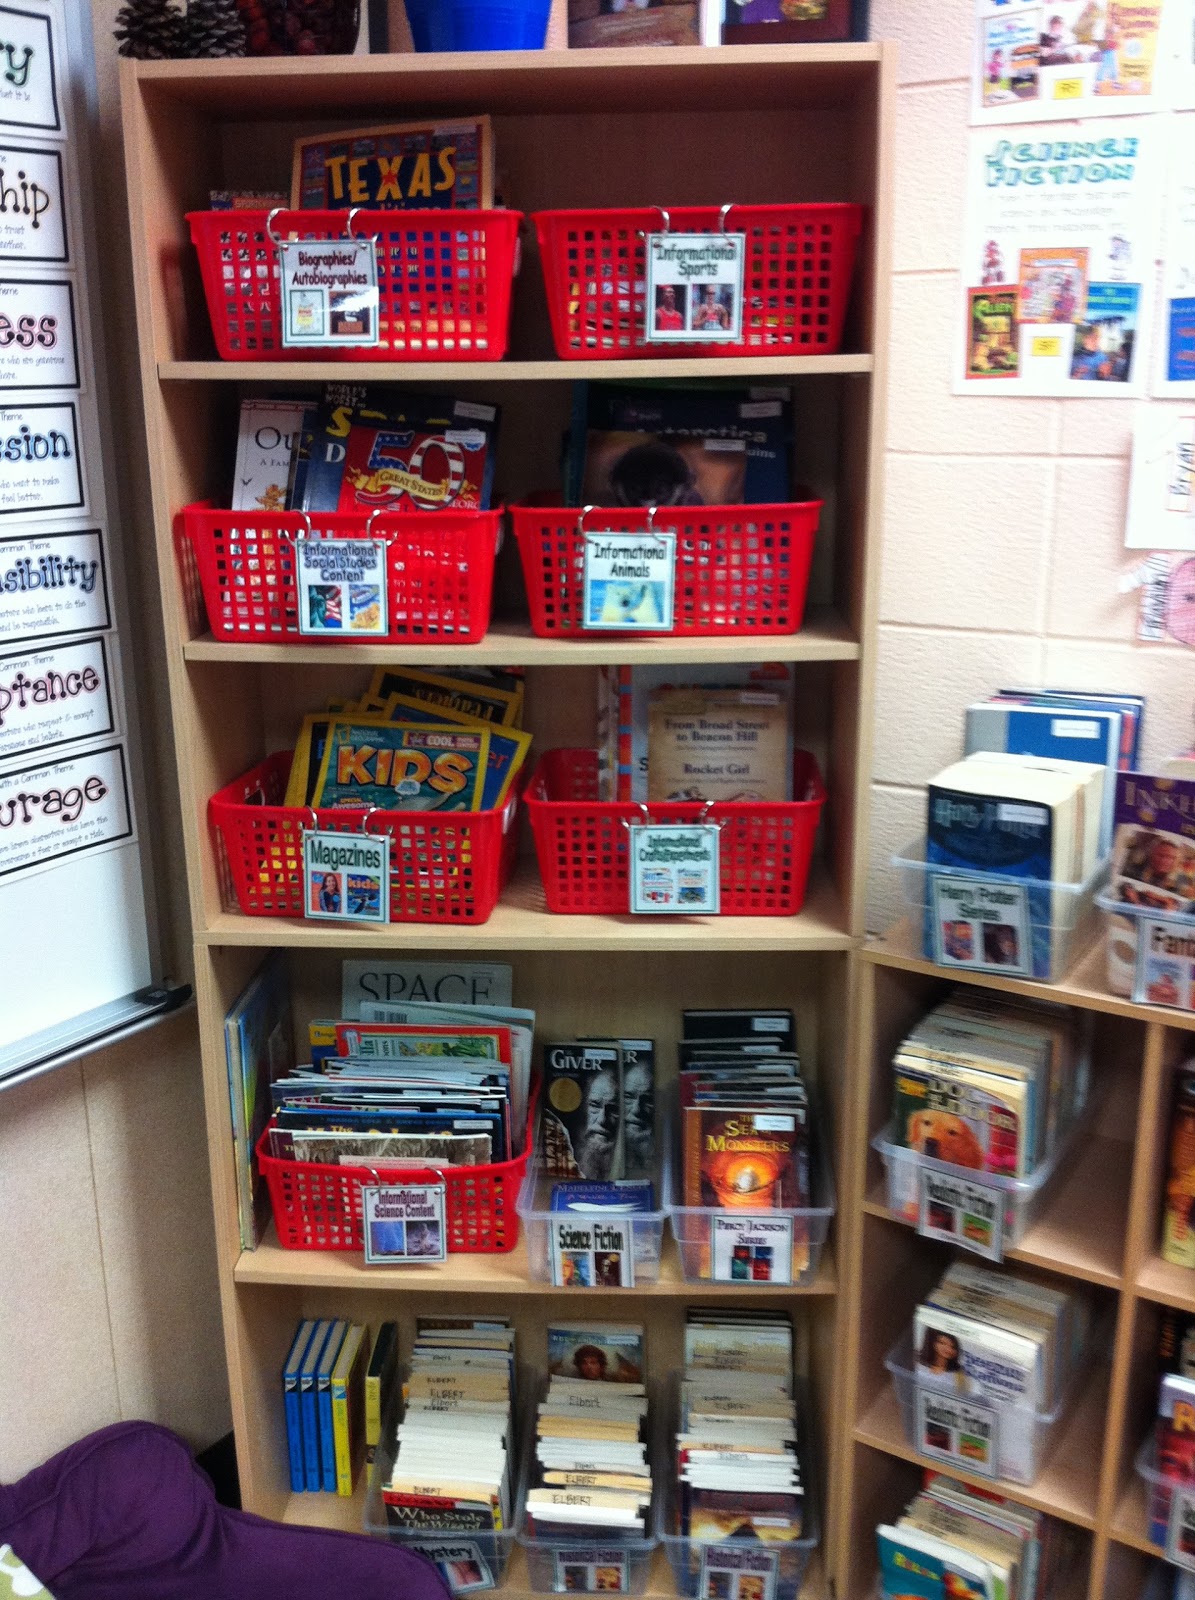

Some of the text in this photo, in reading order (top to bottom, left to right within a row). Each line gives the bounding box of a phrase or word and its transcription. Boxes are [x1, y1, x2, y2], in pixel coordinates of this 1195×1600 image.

[985, 138, 1139, 163] SCIENCE
[325, 146, 456, 203] TEXAS
[984, 163, 1135, 187] FICTION
[292, 270, 368, 289] Autobiographies
[678, 261, 718, 280] Sports
[0, 426, 71, 461] sion
[304, 541, 377, 557] Informational
[594, 542, 667, 560] Informational
[305, 554, 377, 569] Social Studies
[610, 561, 650, 578] Animals
[0, 555, 97, 592] sibility
[321, 569, 364, 582] Content
[700, 719, 733, 730] Broad
[676, 730, 759, 742] to Beacon Hill
[337, 744, 474, 796] KIDS
[684, 763, 750, 775] Rocket Girl
[311, 840, 382, 872] Magazines
[358, 971, 494, 1006] SPACE
[551, 1049, 602, 1071] GIVER
[706, 1134, 791, 1152] MONSTERS
[378, 1190, 428, 1205] Informational
[374, 1203, 435, 1218] Science Content
[559, 1223, 624, 1251] Science Fiction
[552, 1494, 593, 1506] ELBERT
[392, 1505, 485, 1522] Who Stole
[405, 1519, 481, 1530] The Wizard
